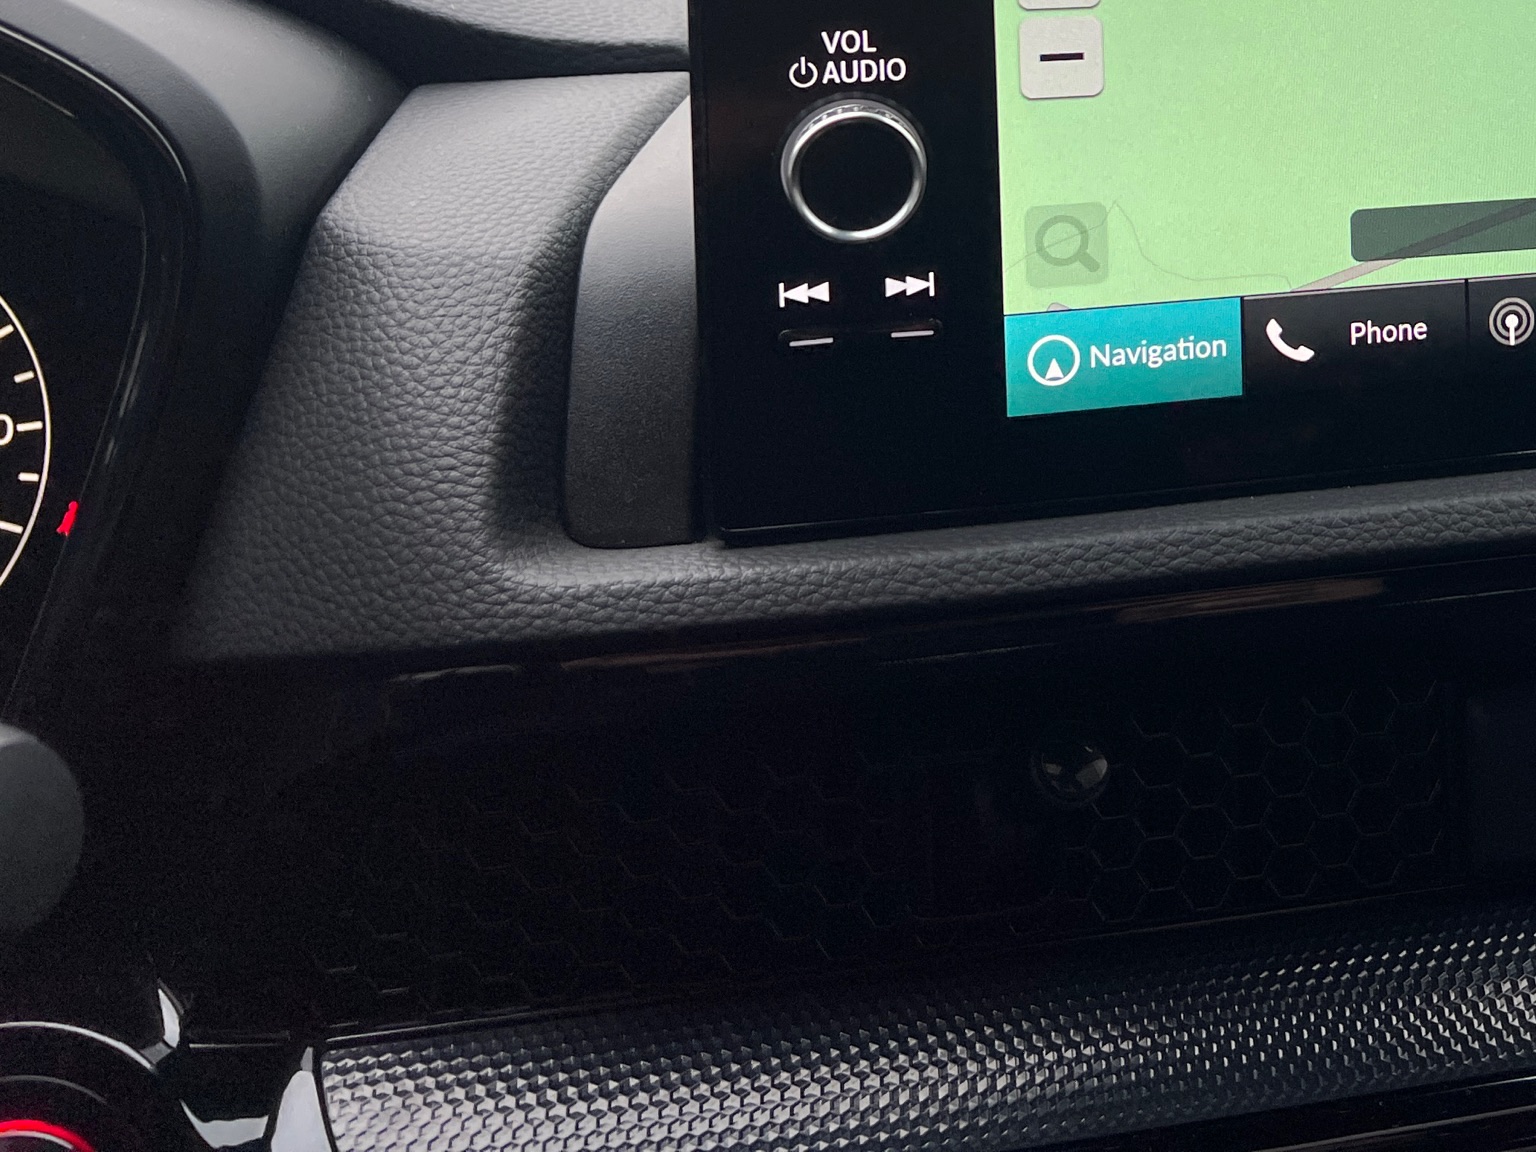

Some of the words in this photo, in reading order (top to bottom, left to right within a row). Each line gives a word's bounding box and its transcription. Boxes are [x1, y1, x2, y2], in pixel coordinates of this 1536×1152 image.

[820, 29, 877, 55] VOL
[822, 56, 907, 85] AUDIO
[1350, 319, 1428, 346] Phone
[1090, 336, 1227, 369] Navigation
